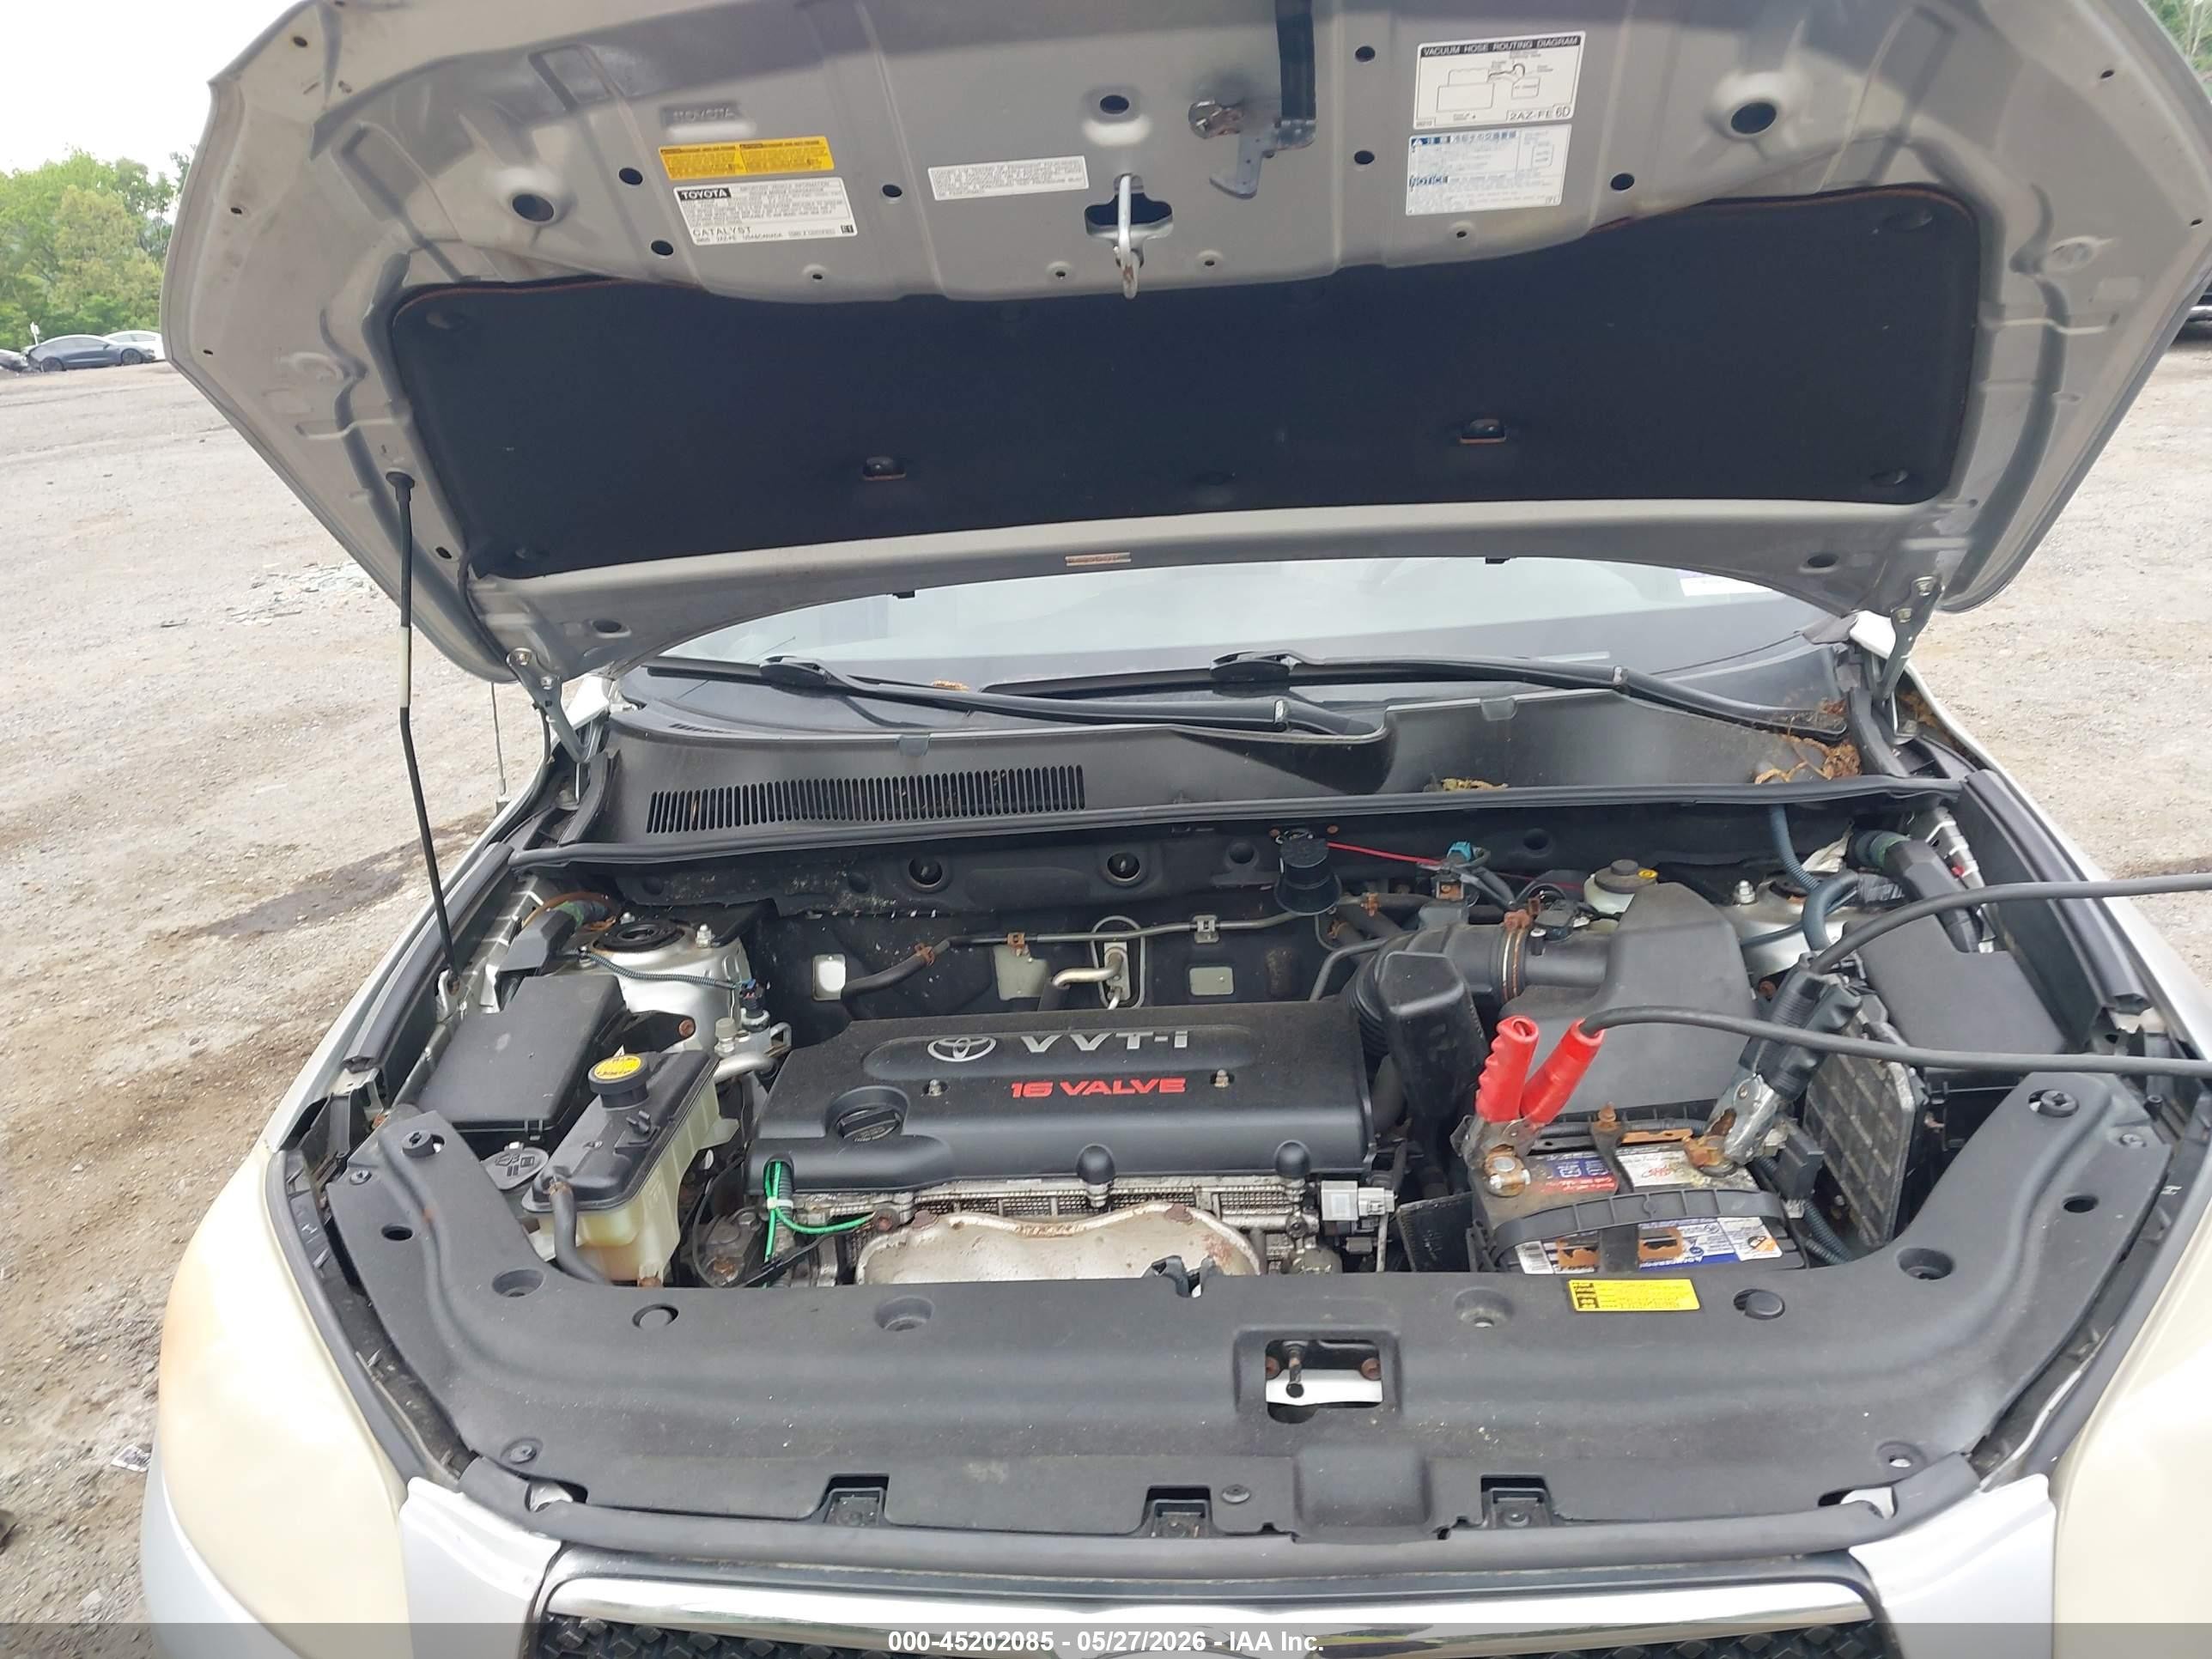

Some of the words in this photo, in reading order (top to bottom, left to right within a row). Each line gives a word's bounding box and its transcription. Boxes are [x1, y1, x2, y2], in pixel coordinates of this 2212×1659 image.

[1423, 46, 1461, 57] VACUUM
[1464, 45, 1489, 53] HOSE
[1492, 41, 1533, 52] ROUTING
[1537, 37, 1578, 49] DIAGRAM
[1556, 106, 1571, 118] 6D
[682, 188, 728, 199] TOYOTA
[693, 227, 751, 238] CATALYST
[1021, 1030, 1188, 1053] VVT-i
[1011, 1081, 1054, 1098] 16
[1060, 1078, 1186, 1095] VALVE
